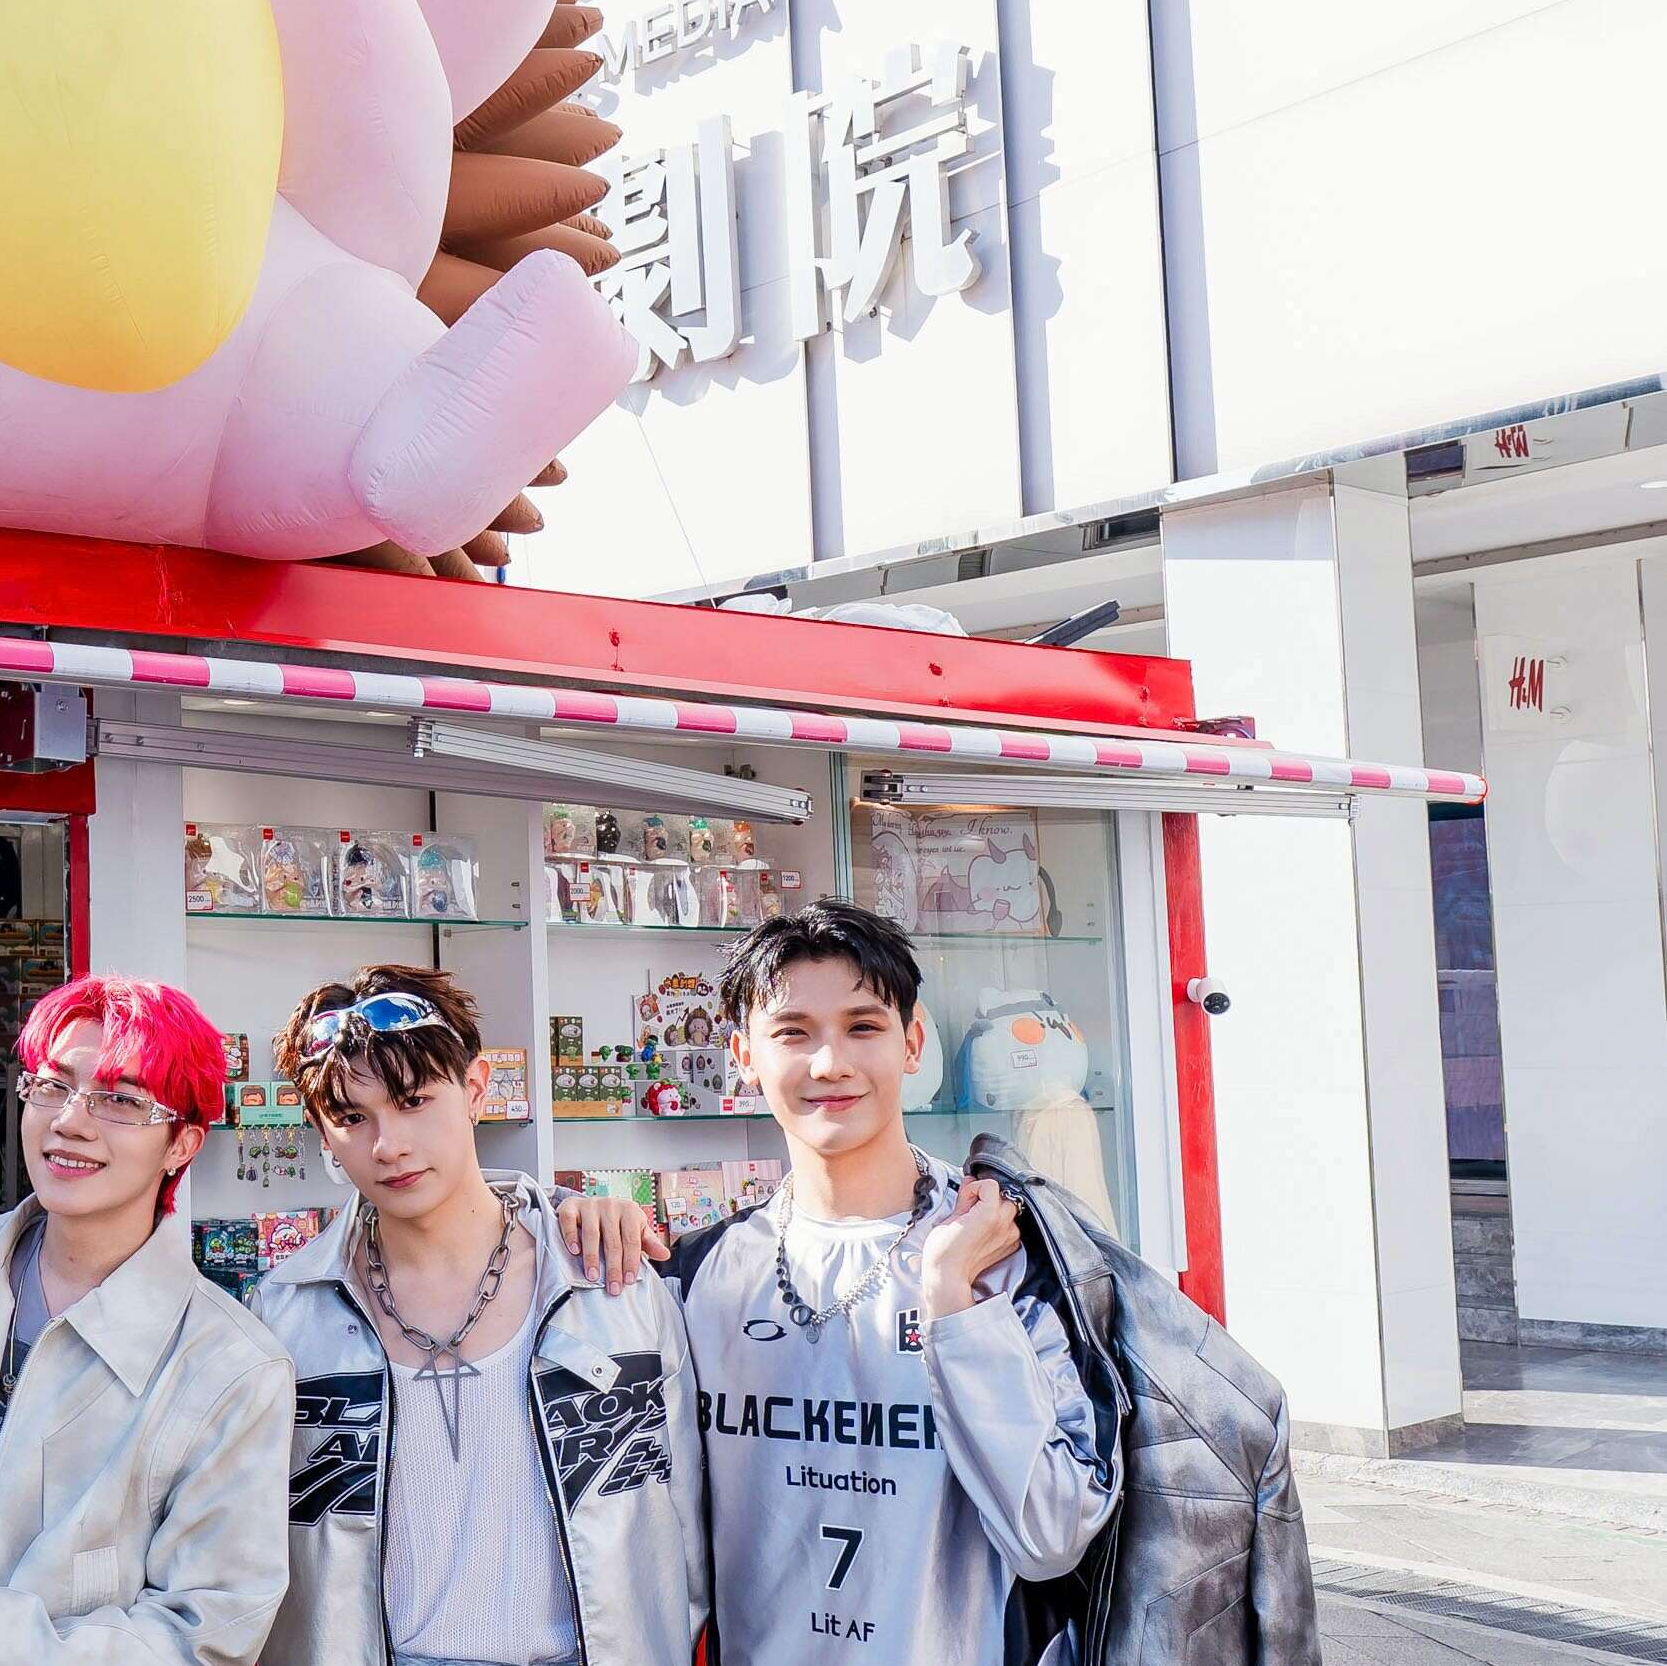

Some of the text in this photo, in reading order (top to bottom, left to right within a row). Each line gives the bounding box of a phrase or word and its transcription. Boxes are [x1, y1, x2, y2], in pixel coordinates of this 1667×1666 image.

[1509, 656, 1544, 712] H&M
[785, 1465, 897, 1496] Lituation
[819, 1523, 865, 1591] 7
[811, 1612, 876, 1642] Lit AF
